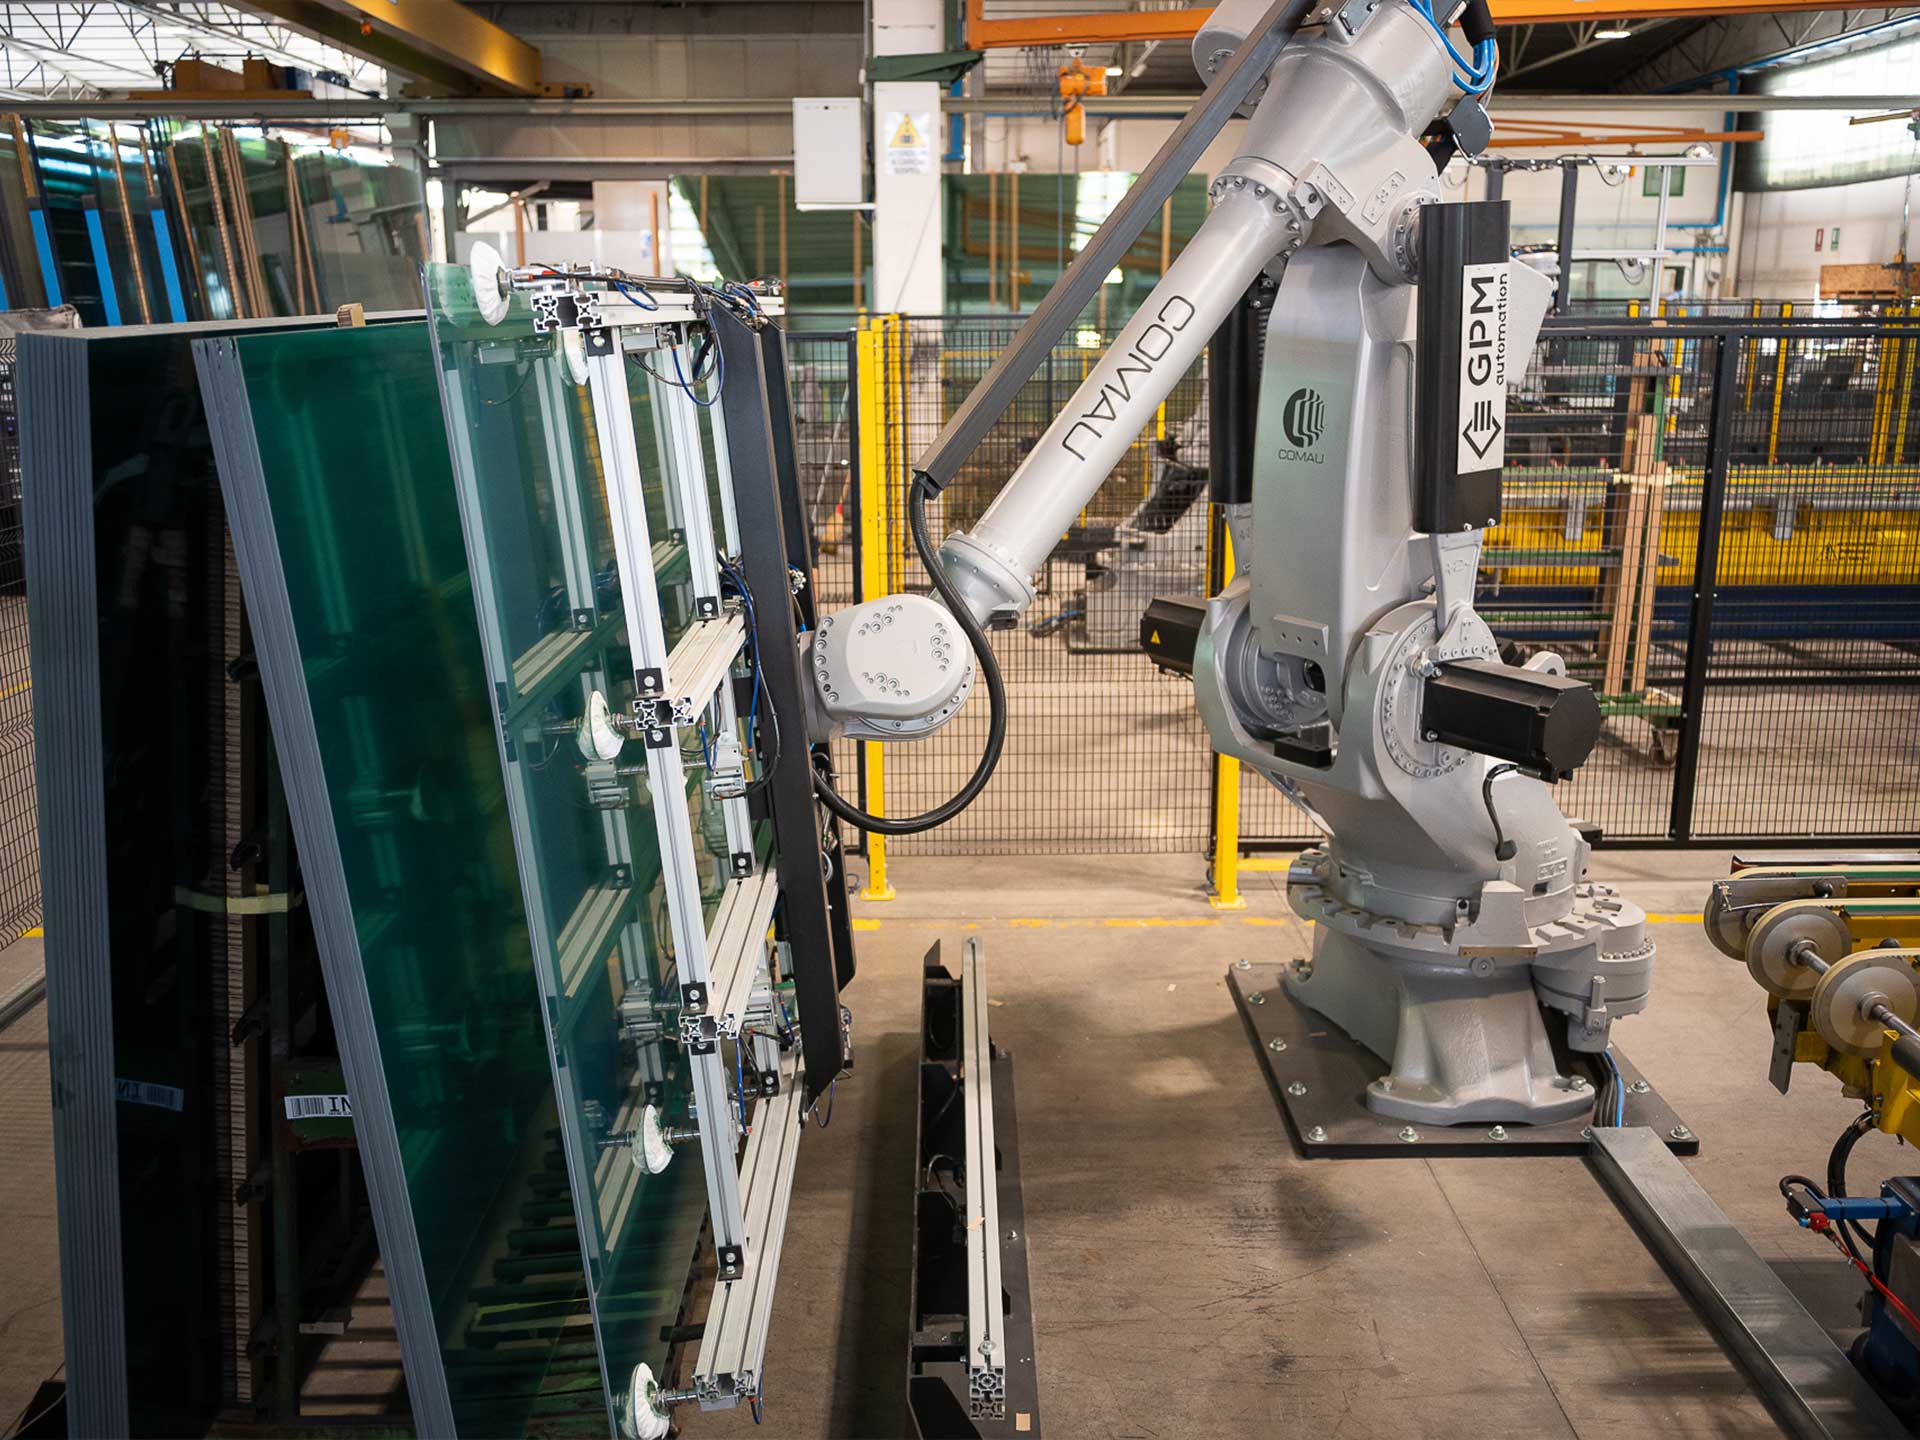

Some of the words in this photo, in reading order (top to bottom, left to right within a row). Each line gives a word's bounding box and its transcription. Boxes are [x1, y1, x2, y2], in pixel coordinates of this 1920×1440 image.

[1062, 295, 1195, 461] COMAU
[1468, 277, 1494, 386] GPM
[1496, 273, 1508, 386] automation
[1278, 449, 1324, 464] COMAU
